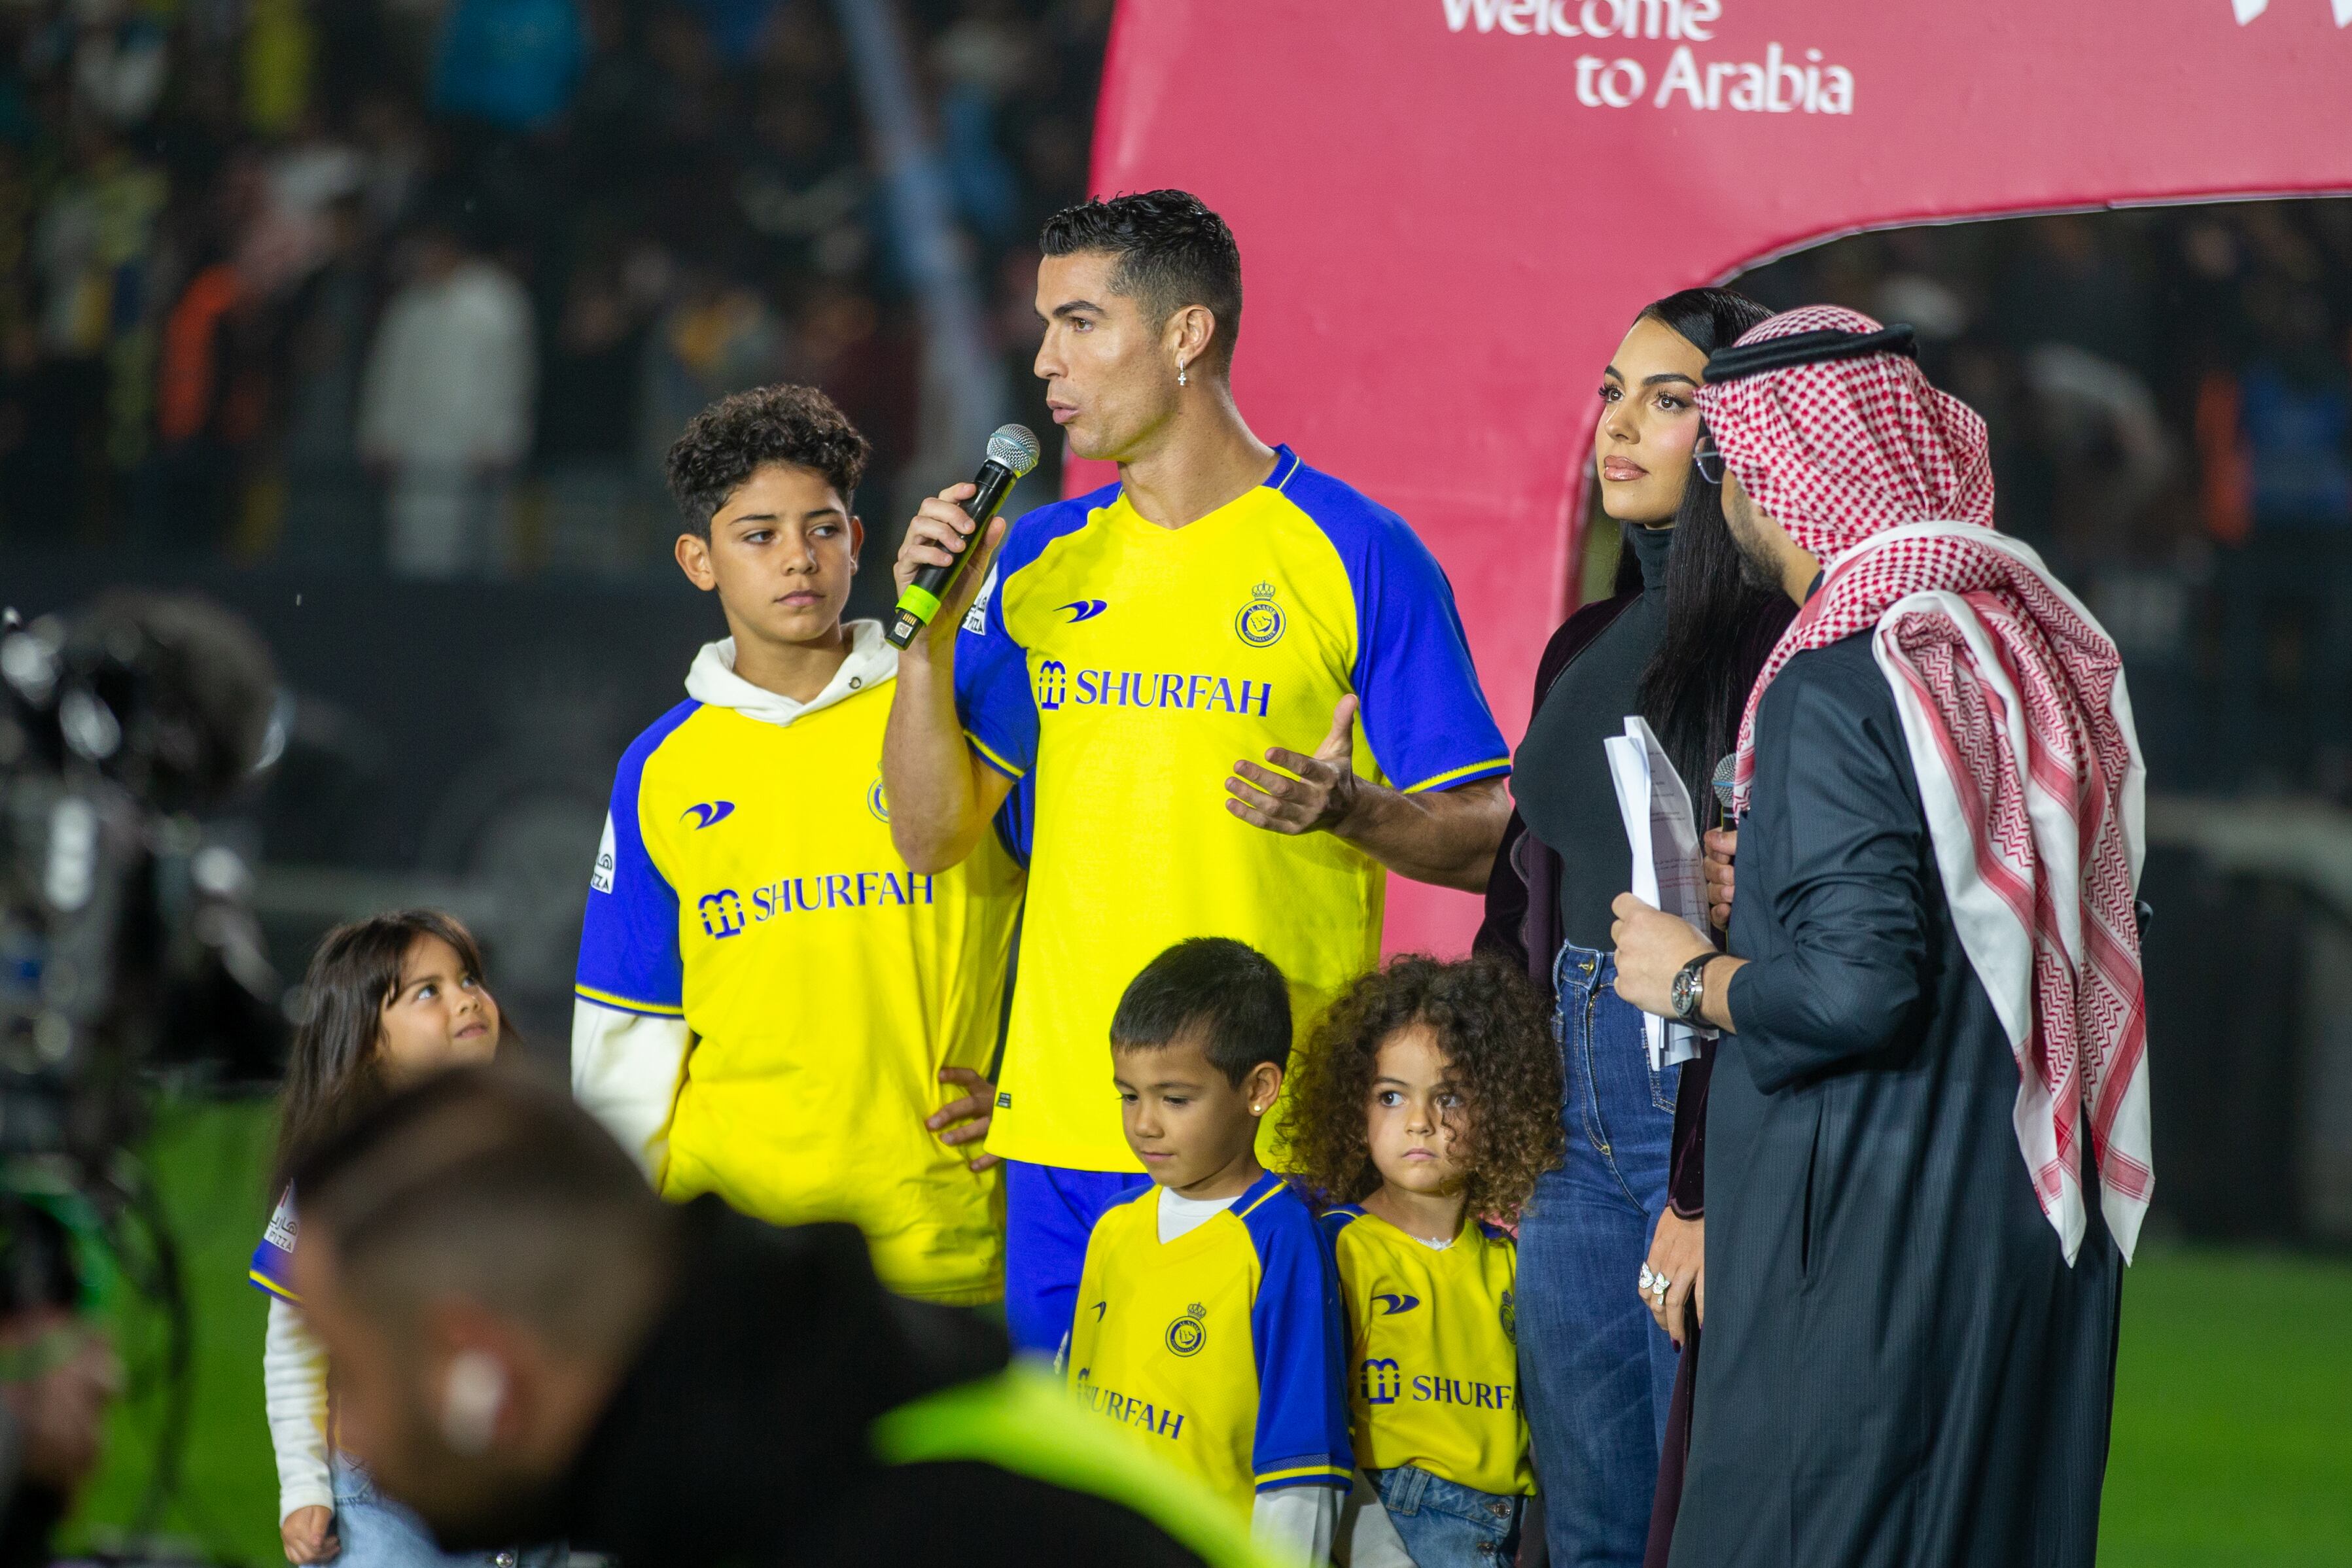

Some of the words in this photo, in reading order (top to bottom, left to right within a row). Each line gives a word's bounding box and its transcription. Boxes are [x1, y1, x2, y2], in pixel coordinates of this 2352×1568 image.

[1442, 0, 1723, 41] Welcome
[1573, 54, 1647, 108] to
[1653, 41, 1855, 115] Arabia
[1074, 669, 1272, 717] SHURFAH
[752, 872, 933, 922] SHURFAH
[1085, 1385, 1184, 1440] URFAH
[1413, 1375, 1517, 1410] SHURF
